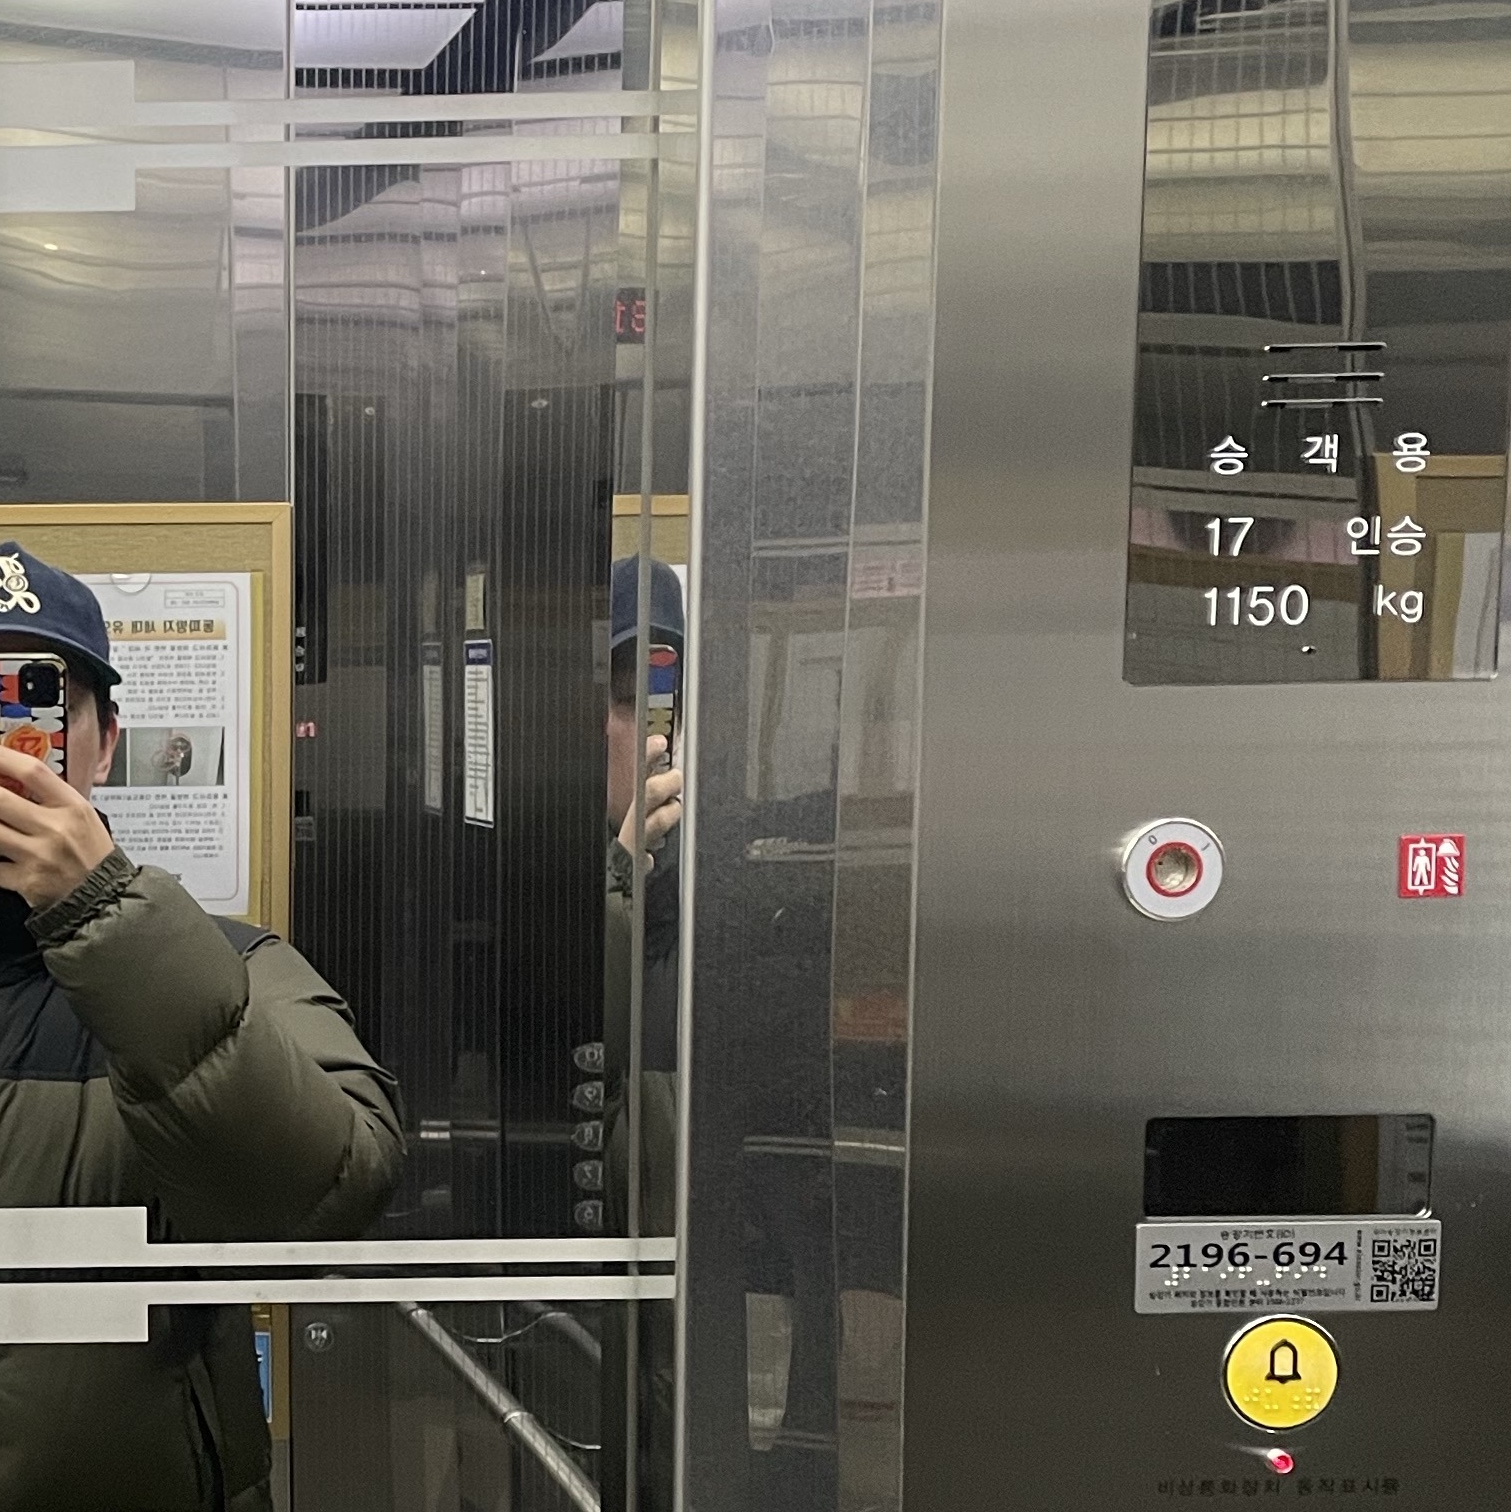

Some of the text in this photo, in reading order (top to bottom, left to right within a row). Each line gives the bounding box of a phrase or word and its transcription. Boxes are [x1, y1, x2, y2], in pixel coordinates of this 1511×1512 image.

[1208, 431, 1431, 476] 승 객 용
[1204, 514, 1426, 557] 17 인승
[1203, 584, 1425, 627] 1150 kg
[1148, 1240, 1349, 1269] 2196-694
